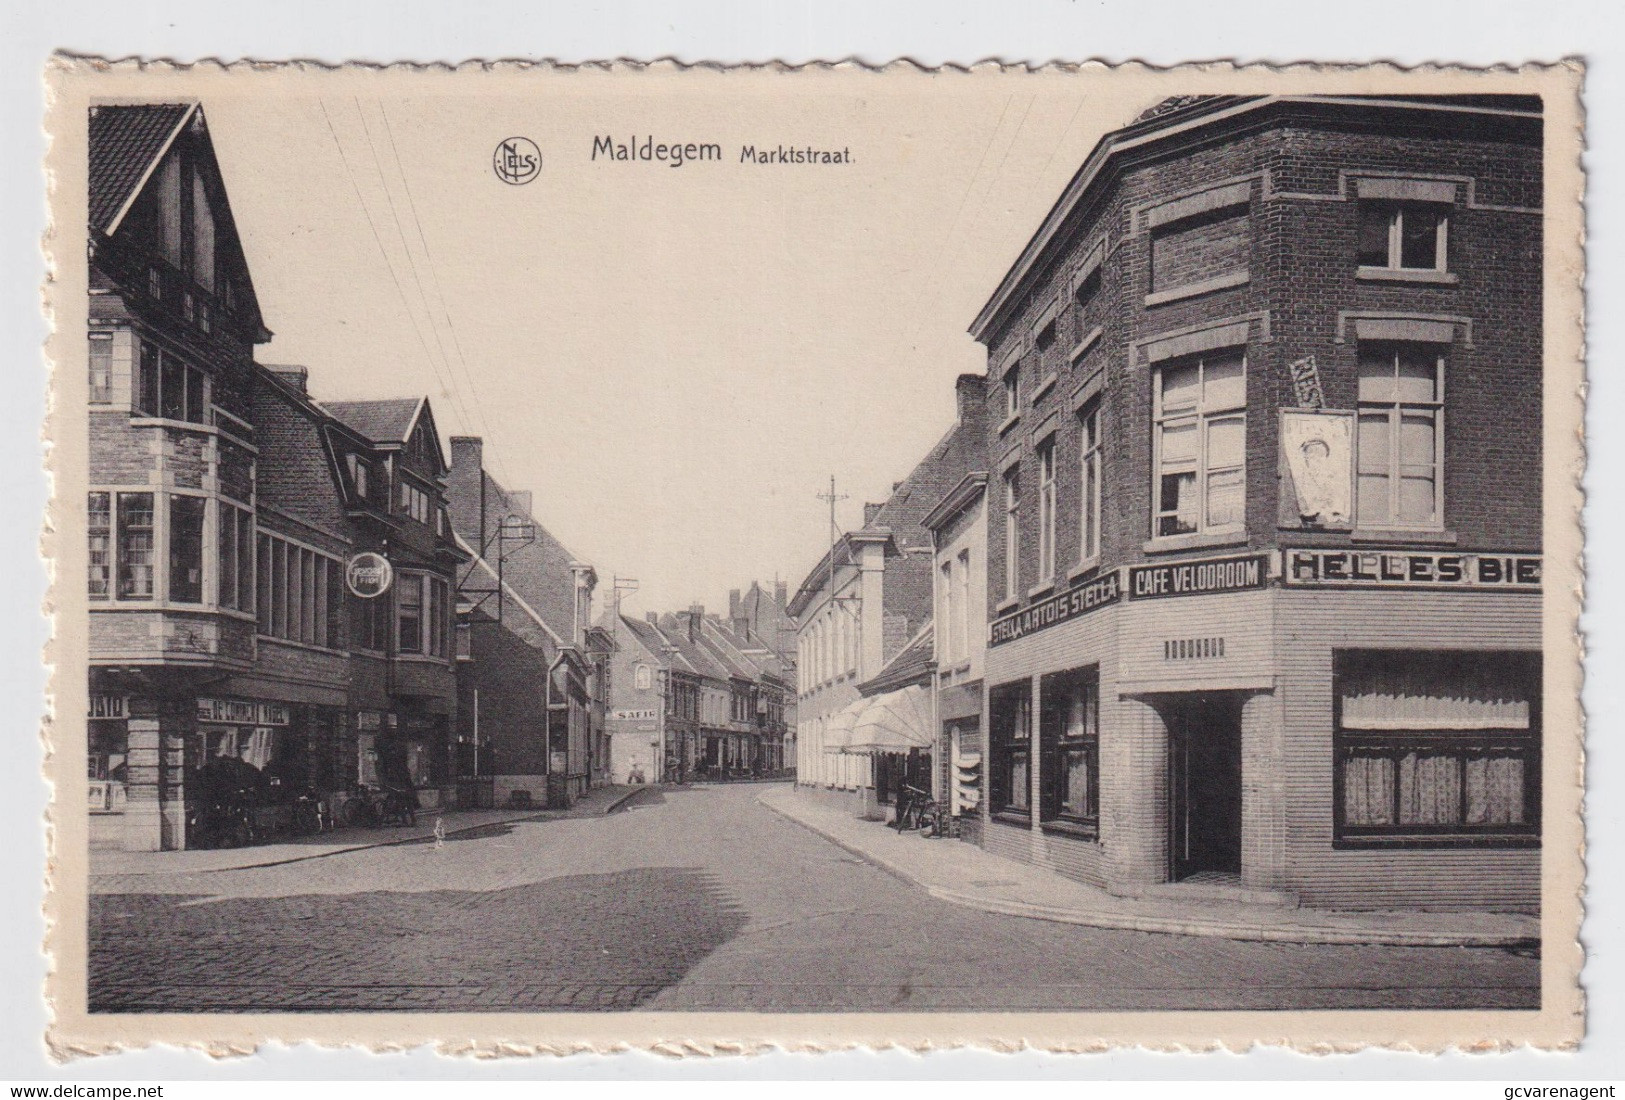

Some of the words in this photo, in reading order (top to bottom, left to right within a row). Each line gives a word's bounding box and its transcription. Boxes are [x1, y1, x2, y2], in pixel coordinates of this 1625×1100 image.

[1135, 568, 1169, 596] CAFE
[1172, 559, 1260, 591] VELODROOM
[1293, 553, 1463, 582] HELLES
[992, 619, 1025, 644] STELLA
[1024, 598, 1068, 631] ARTOIS
[1070, 576, 1118, 614] STELLA
